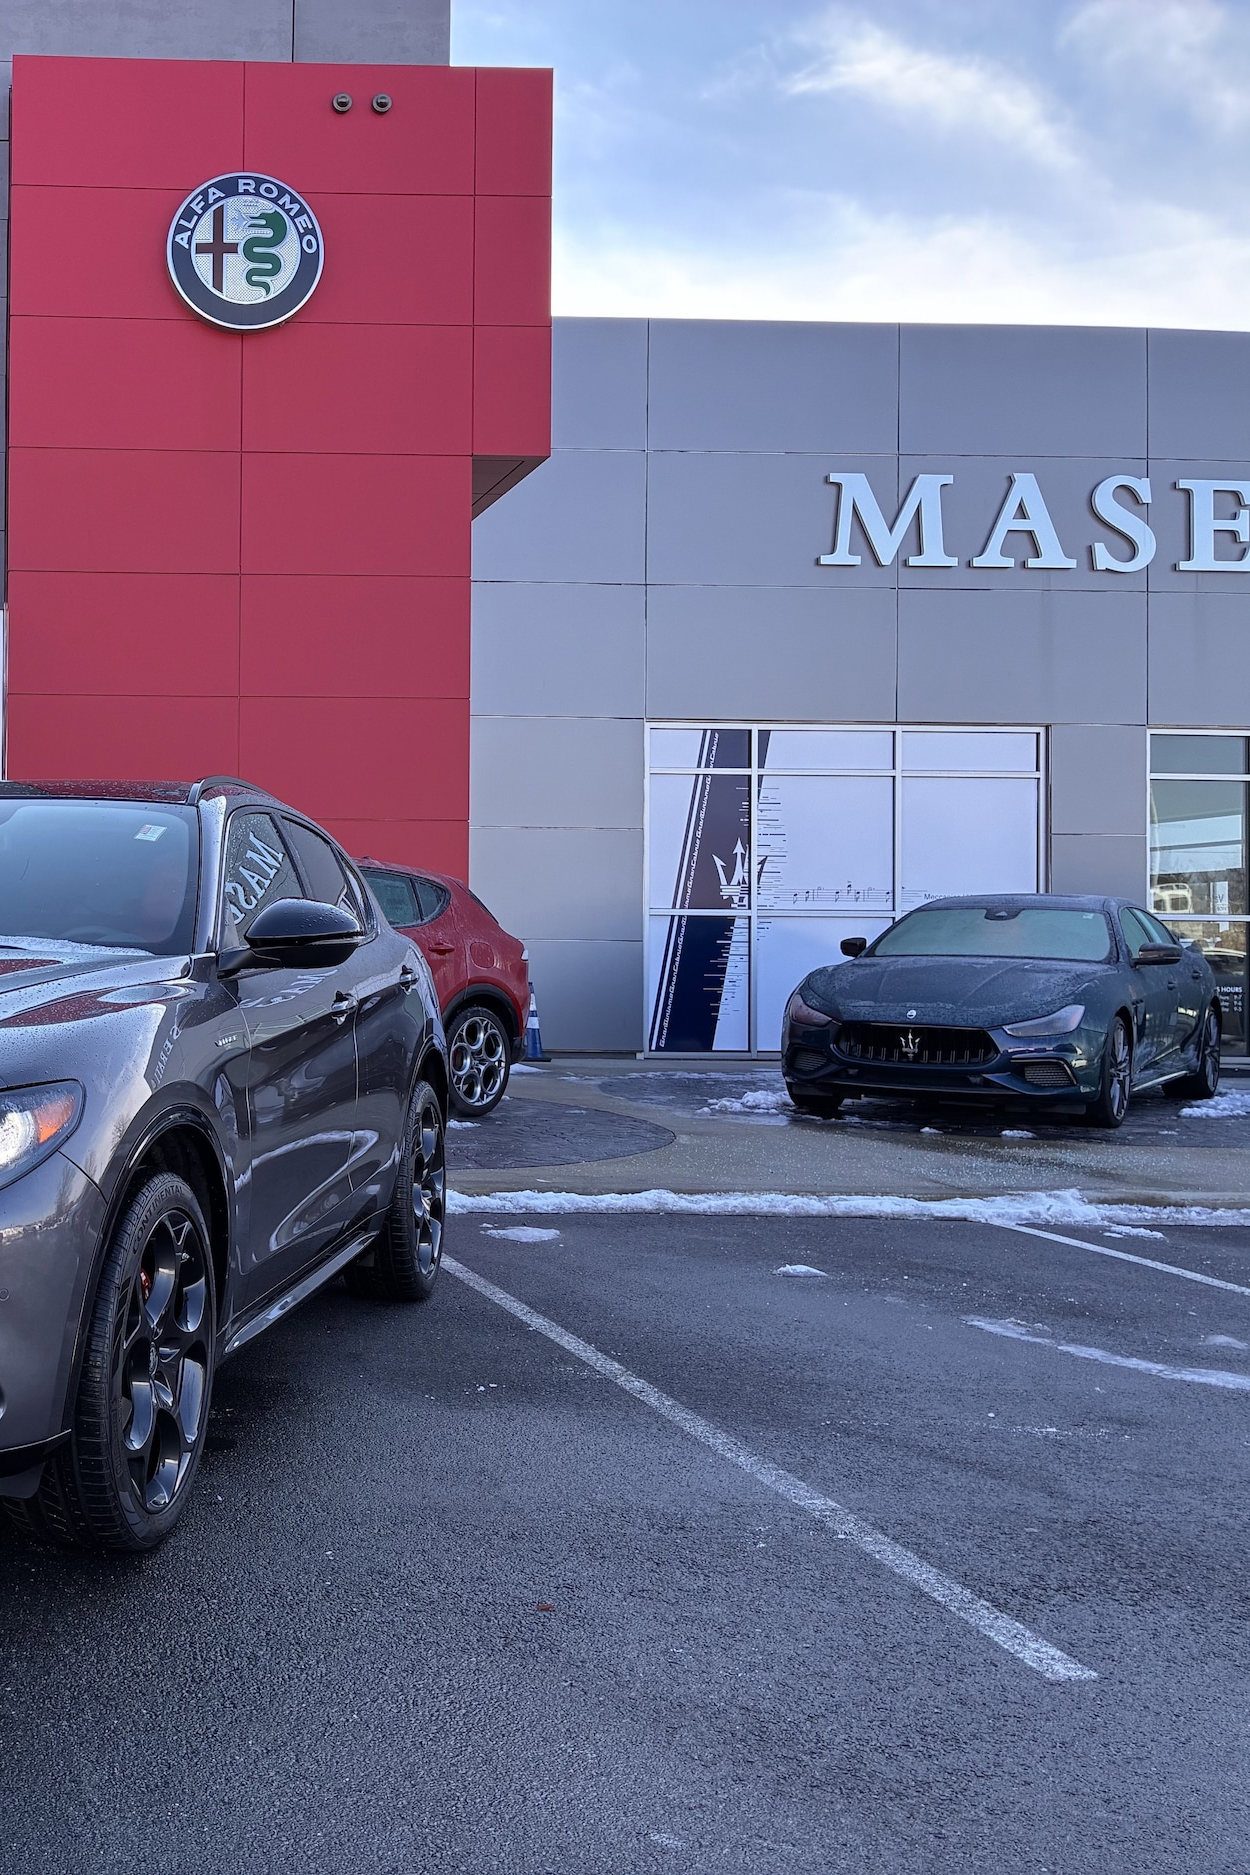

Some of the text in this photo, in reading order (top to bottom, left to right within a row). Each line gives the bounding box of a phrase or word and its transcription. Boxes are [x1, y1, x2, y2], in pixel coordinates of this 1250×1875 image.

[174, 178, 317, 254] ALFA ROMEO
[817, 472, 1250, 574] MASE
